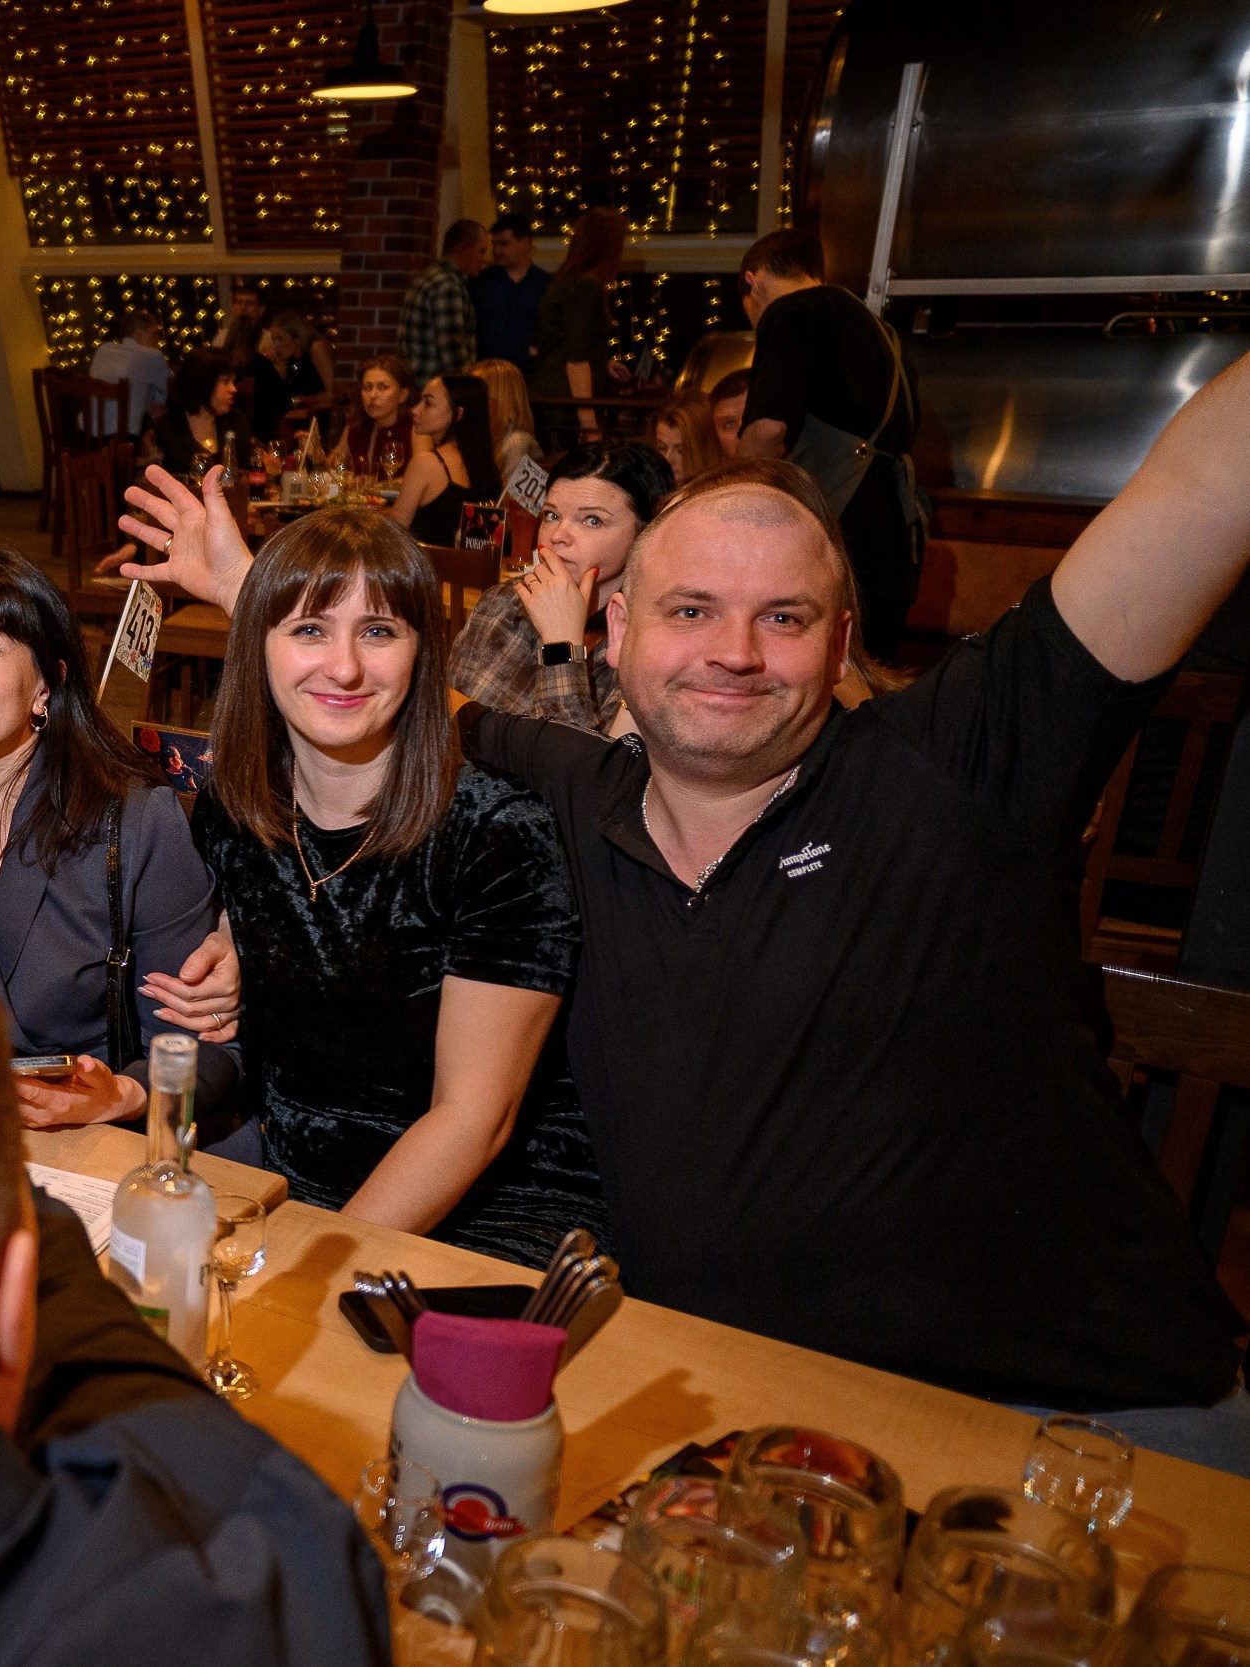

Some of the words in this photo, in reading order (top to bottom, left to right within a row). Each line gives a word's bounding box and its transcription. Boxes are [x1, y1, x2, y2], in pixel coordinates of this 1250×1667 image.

[514, 469, 546, 505] 201
[126, 602, 155, 657] 413
[787, 860, 824, 878] COMPLETE
